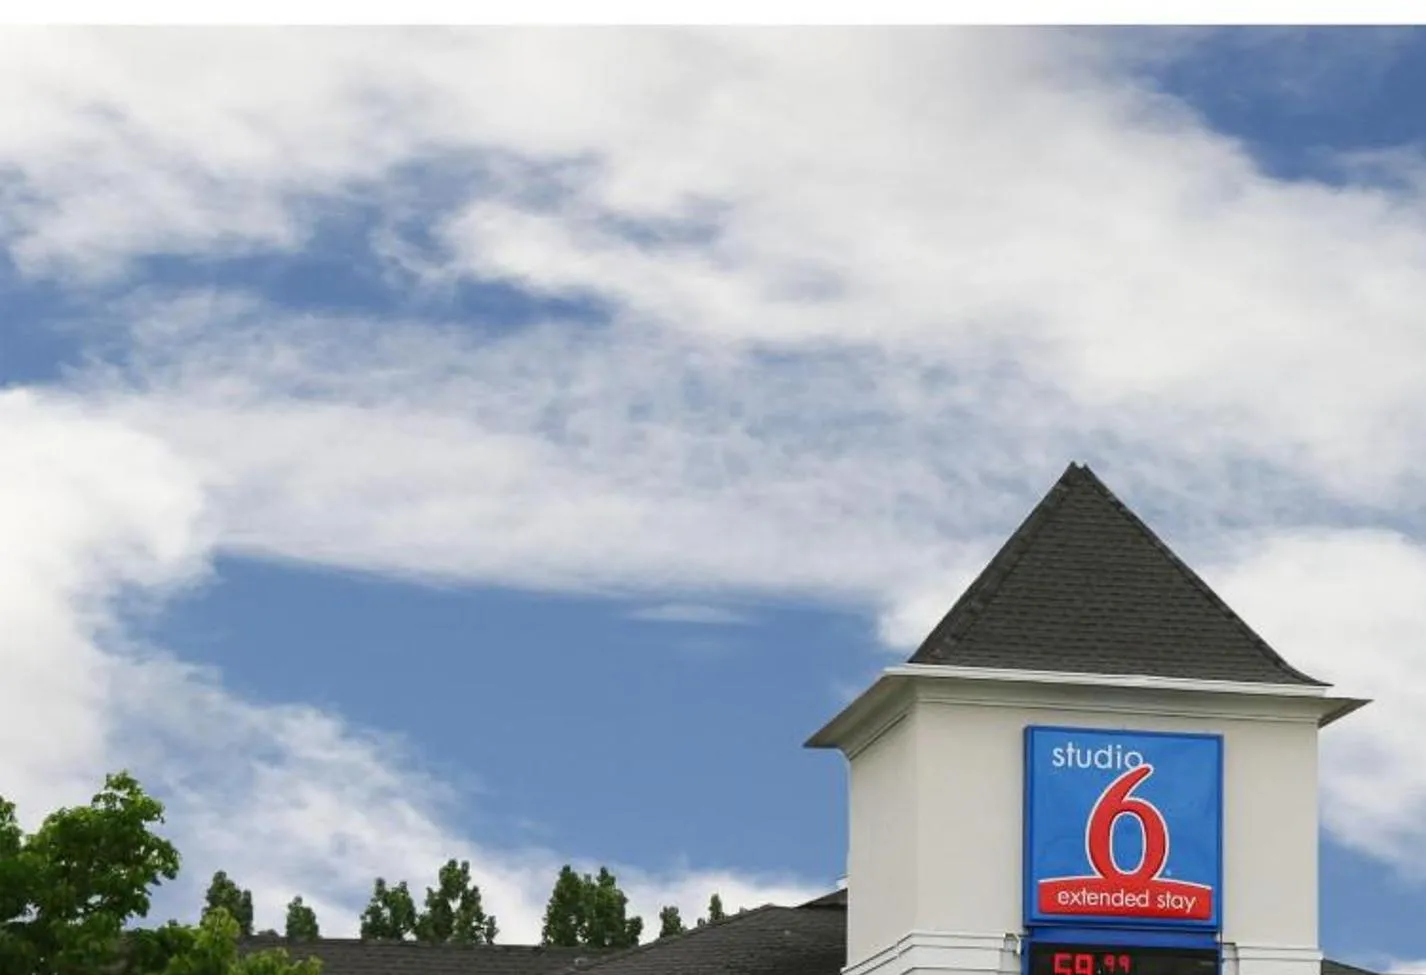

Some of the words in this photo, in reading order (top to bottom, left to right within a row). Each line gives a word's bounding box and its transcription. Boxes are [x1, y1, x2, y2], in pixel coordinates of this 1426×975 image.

[1052, 742, 1144, 770] studio
[1086, 764, 1169, 884] 6
[1057, 888, 1150, 908] extended
[1156, 893, 1197, 913] stay
